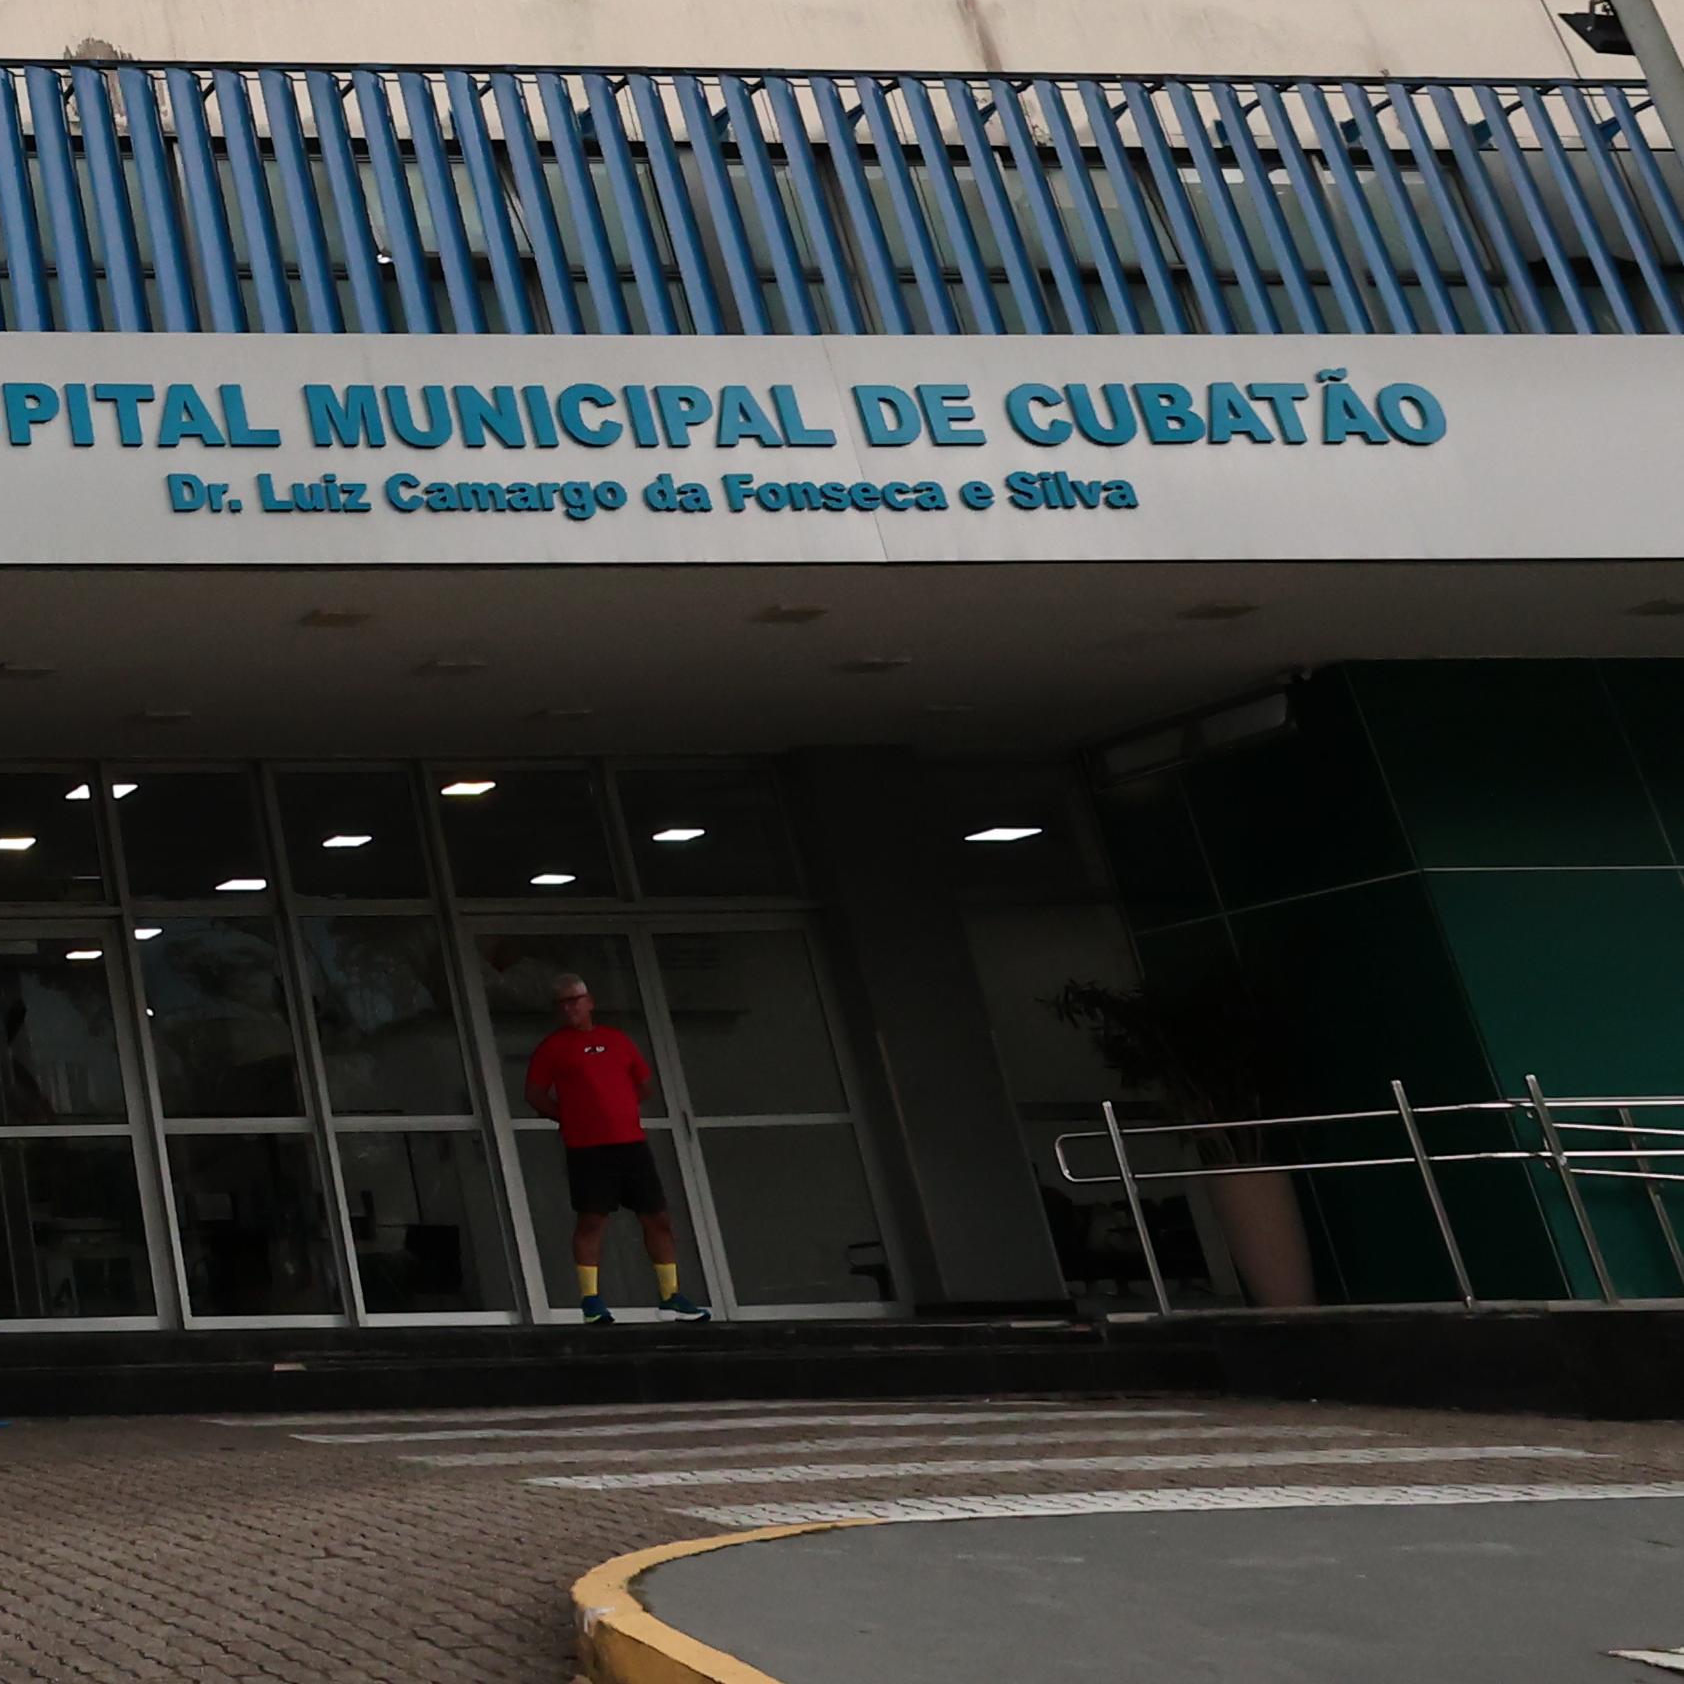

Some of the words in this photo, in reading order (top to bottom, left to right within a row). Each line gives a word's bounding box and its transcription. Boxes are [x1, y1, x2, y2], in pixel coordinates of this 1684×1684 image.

[303, 382, 837, 449] MUNICIPAL
[851, 383, 987, 448] DE
[1005, 367, 1447, 447] CUBATÃO
[166, 472, 241, 513] Dr.
[257, 472, 372, 513] Luiz
[384, 472, 628, 521] Camargo
[644, 474, 713, 513] da
[723, 473, 948, 513] Fonseca
[960, 481, 994, 511] e
[1006, 471, 1139, 511] Silva
